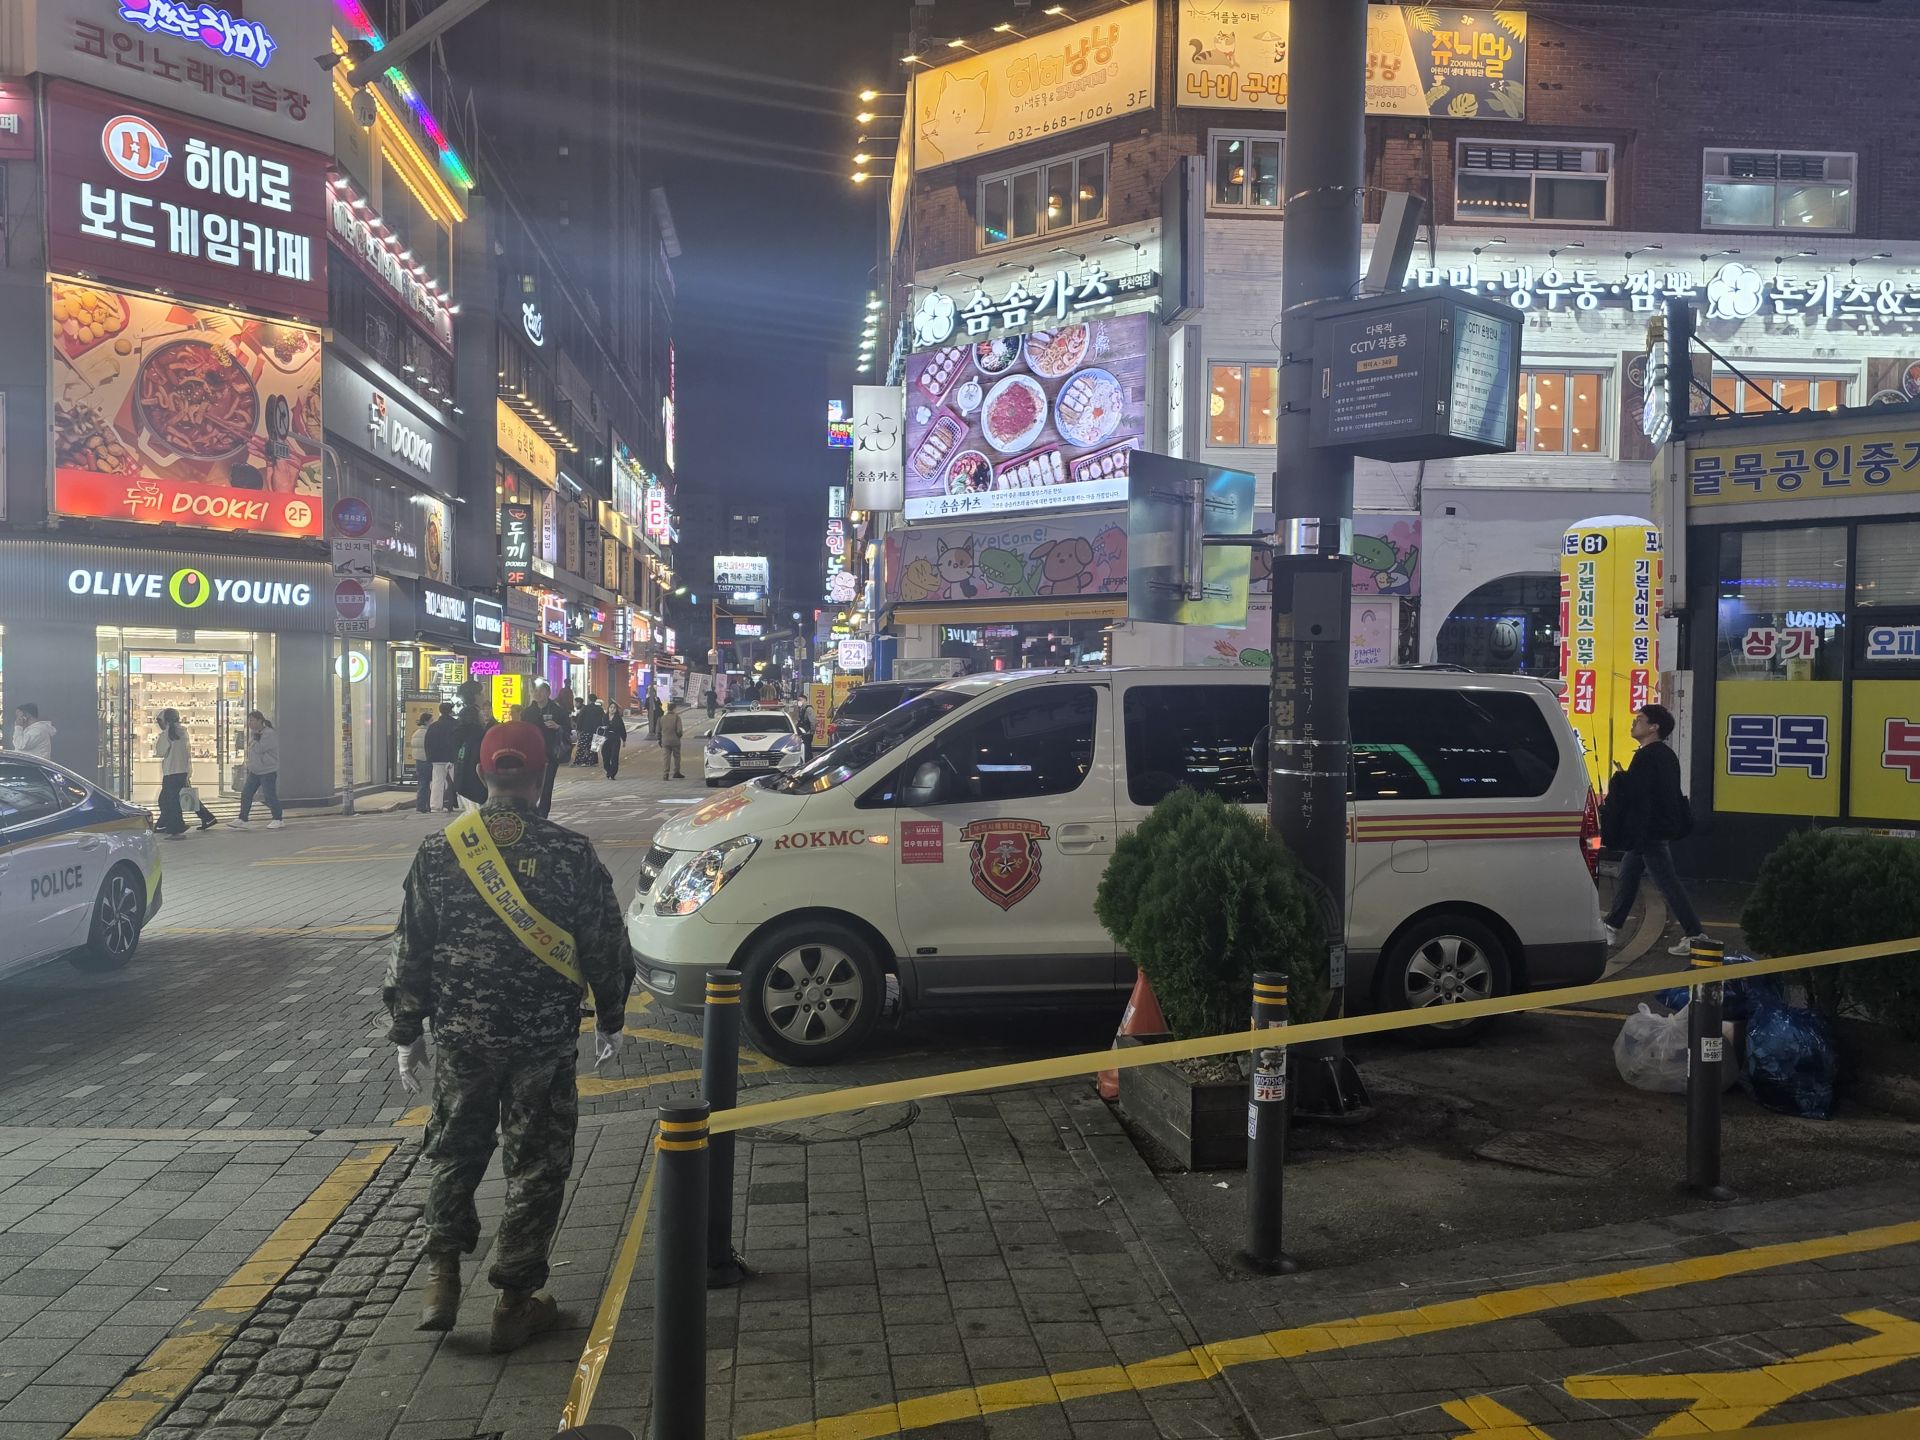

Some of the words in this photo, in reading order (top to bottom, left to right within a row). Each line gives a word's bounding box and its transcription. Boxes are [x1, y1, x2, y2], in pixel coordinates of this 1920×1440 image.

[1460, 15, 1475, 25] 3F
[75, 19, 311, 122] 코인노래연습장
[1430, 66, 1450, 76] 어린이
[1451, 67, 1464, 77] 생태
[1465, 68, 1485, 78] 체험관
[1450, 59, 1485, 68] ZOONIMAL
[1187, 70, 1239, 101] 나비
[1008, 102, 1114, 142] 032-668-1006
[1126, 89, 1148, 108] 3F
[184, 136, 293, 213] 히어로
[960, 265, 1114, 337] 솜솜카츠
[1117, 273, 1152, 291] 부천역점
[1350, 339, 1377, 354] CCTV
[1377, 333, 1408, 350] 작동중
[1366, 322, 1393, 336] 다목적
[855, 469, 900, 483] 솜솜카츠
[122, 486, 164, 515] 두끼
[170, 491, 270, 523] DOOKKI
[287, 505, 310, 522] 2F
[939, 496, 983, 515] 솜솜카츠
[506, 521, 526, 560] 두끼
[1583, 535, 1604, 552] B1
[68, 568, 164, 598] OLIVE
[213, 577, 311, 607] YOUNG
[507, 572, 525, 583] 2F
[1578, 561, 1595, 632] 기본서비스
[1633, 560, 1649, 631] 기본서비스
[844, 650, 862, 661] 24
[1577, 637, 1595, 665] 안주
[1633, 636, 1649, 665] 안주
[1744, 629, 1817, 658] 상가
[1576, 670, 1593, 714] 7가지
[1727, 715, 1830, 780] 물목
[773, 829, 866, 850] ROKMC
[30, 865, 83, 901] POLICE
[1256, 1087, 1284, 1099] 카드
